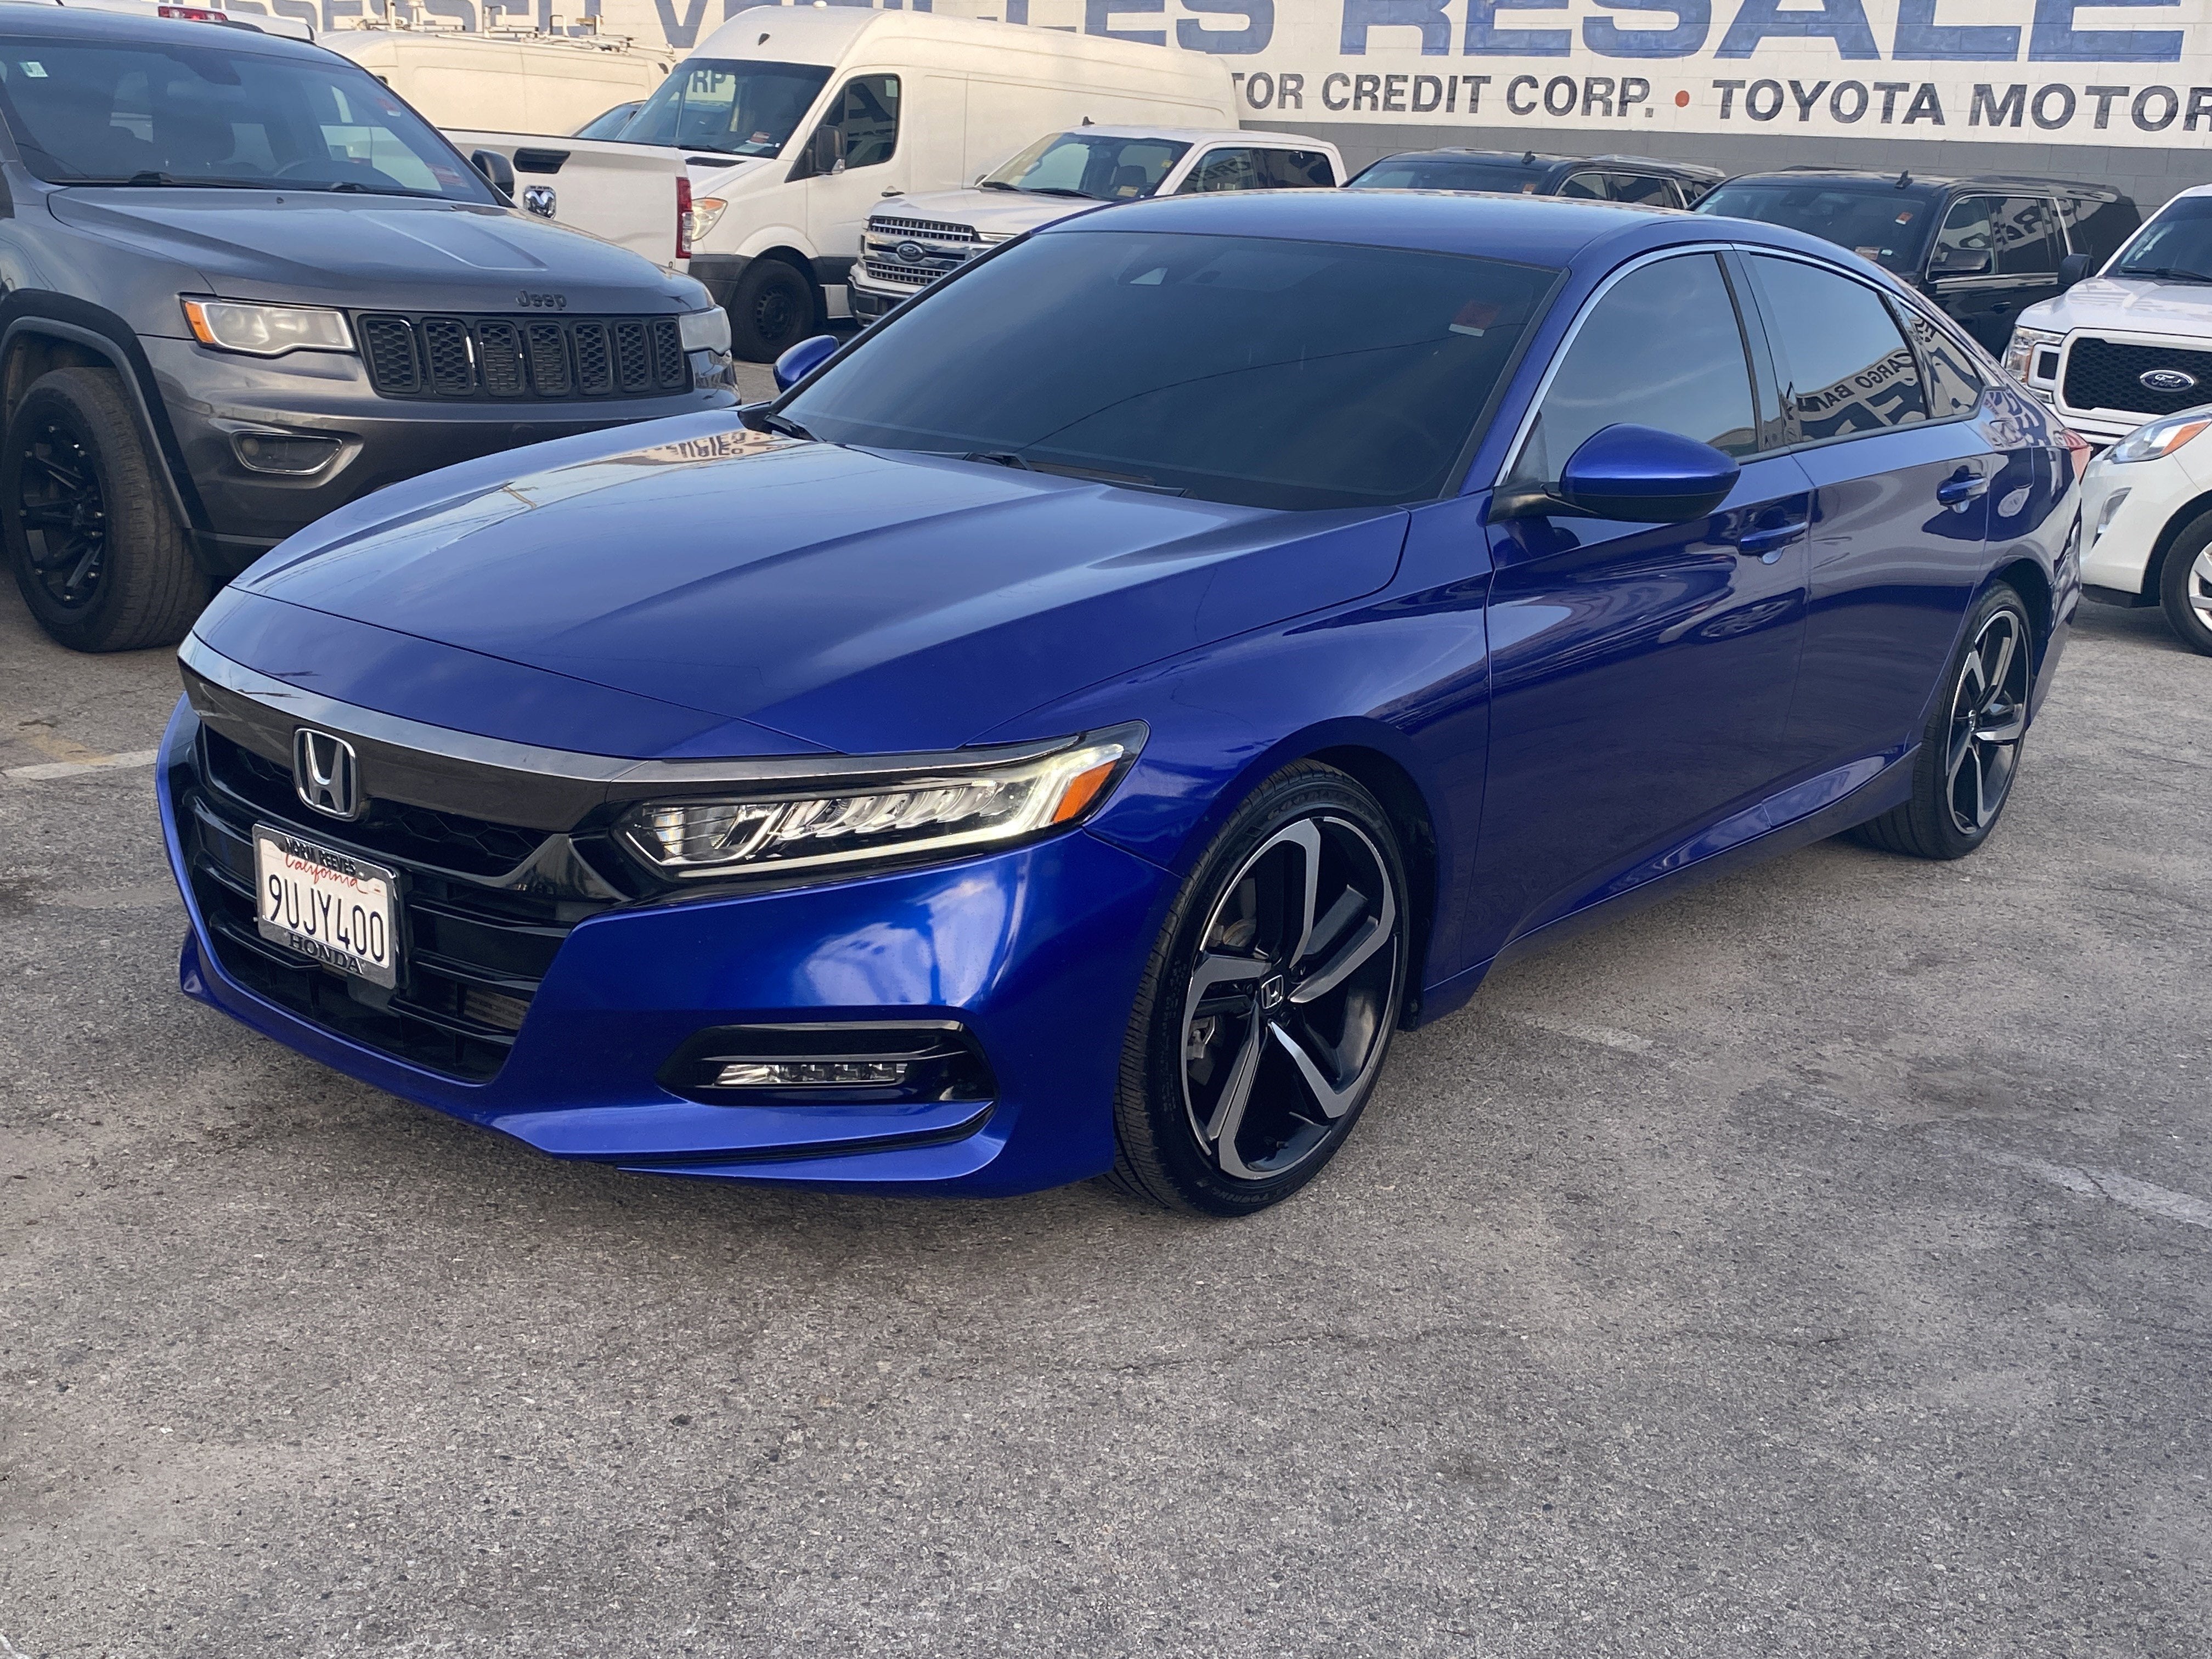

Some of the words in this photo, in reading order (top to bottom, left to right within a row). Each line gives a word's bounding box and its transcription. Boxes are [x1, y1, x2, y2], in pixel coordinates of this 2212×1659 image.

[1321, 72, 1491, 114] CREDIT
[1506, 75, 1654, 119] CORP.
[1712, 79, 1946, 126] TOYOTA
[1968, 84, 2212, 132] MOTOR
[515, 290, 567, 311] Jeep
[285, 853, 369, 894] California
[269, 874, 385, 963] 9UJY400
[289, 932, 364, 975] HONDA
